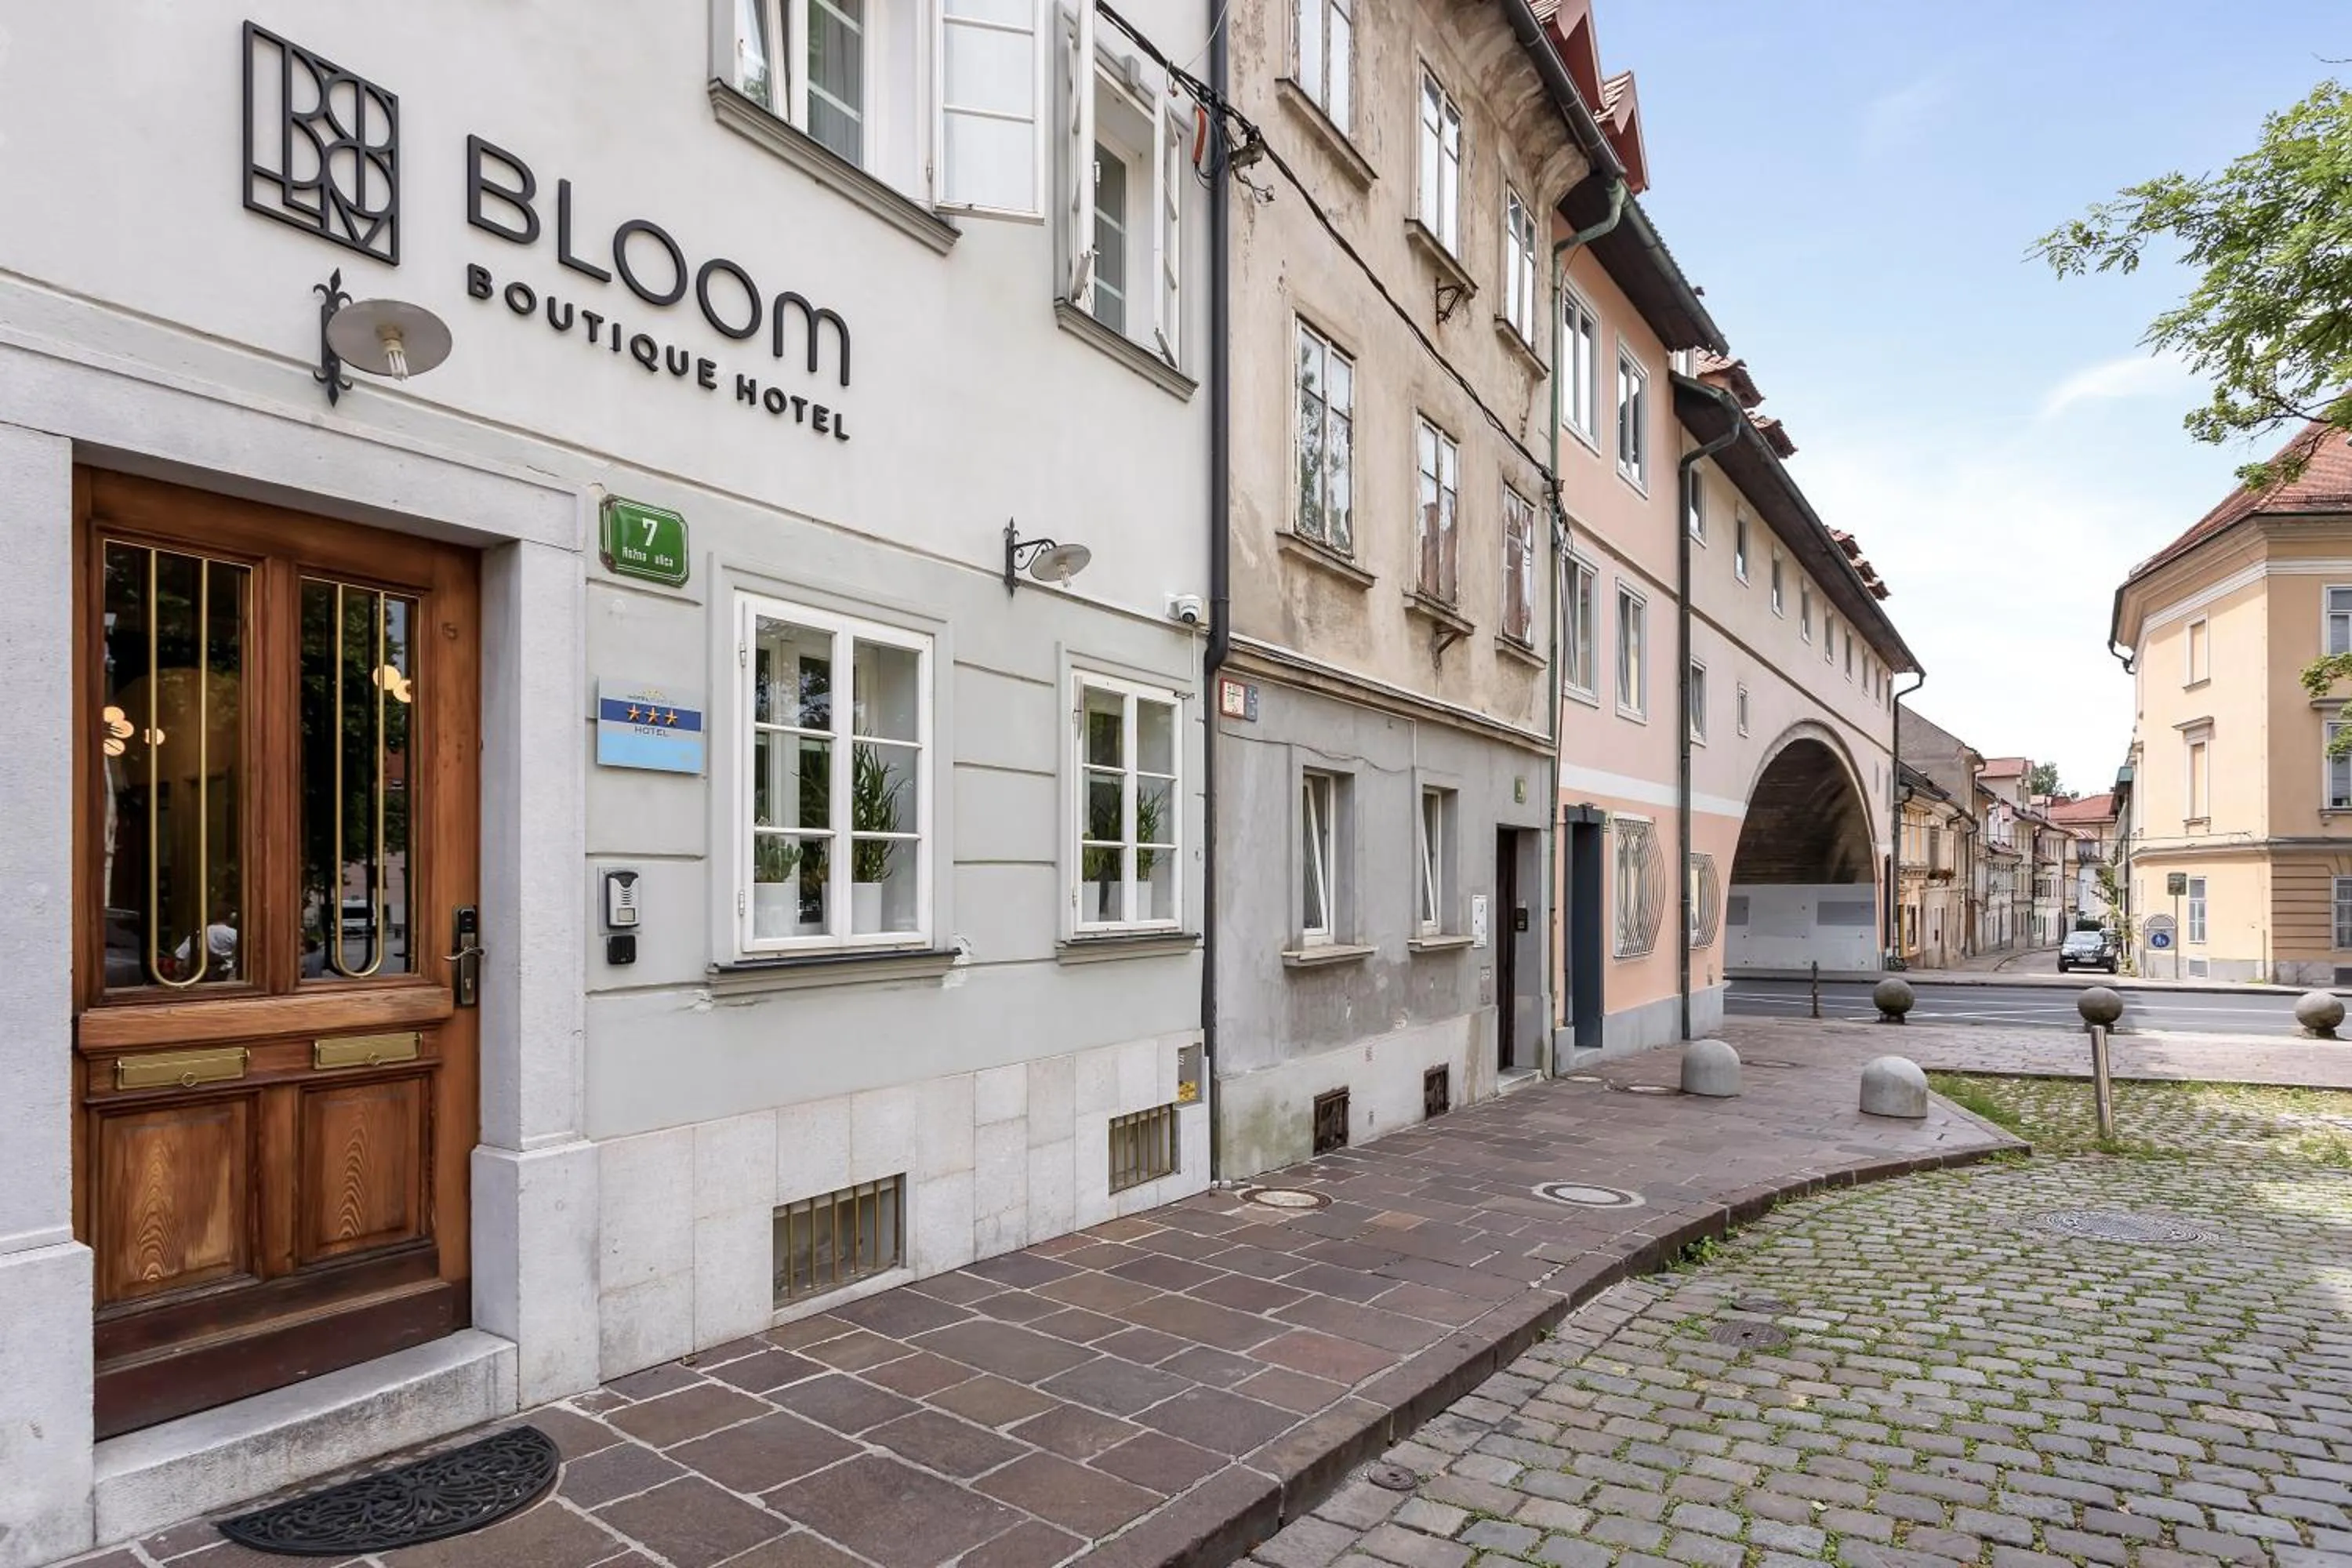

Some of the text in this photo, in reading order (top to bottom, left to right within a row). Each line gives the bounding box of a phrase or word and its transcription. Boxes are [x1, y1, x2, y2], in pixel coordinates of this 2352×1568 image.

[466, 263, 850, 441] BOUTIQUE HOTEL
[642, 517, 658, 546] 7
[634, 726, 669, 737] HOTEL
